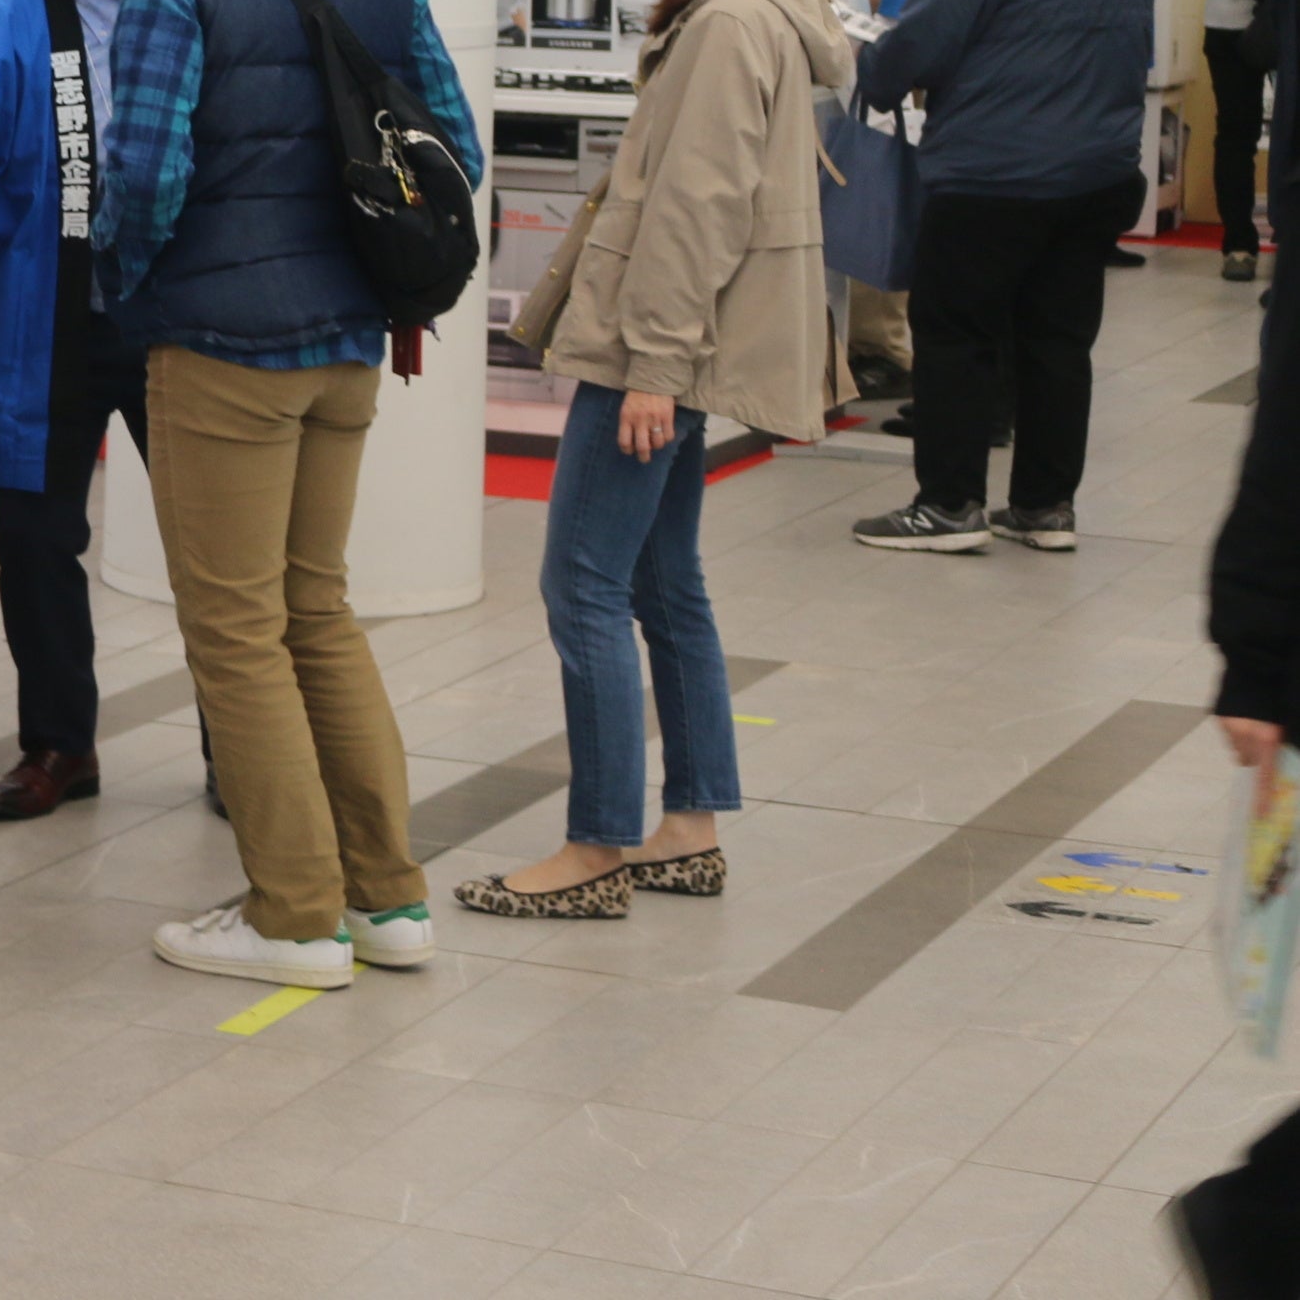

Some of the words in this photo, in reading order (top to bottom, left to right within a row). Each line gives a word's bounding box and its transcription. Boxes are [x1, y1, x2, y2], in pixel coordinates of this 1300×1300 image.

[49, 48, 92, 241] 習志野市企業局
